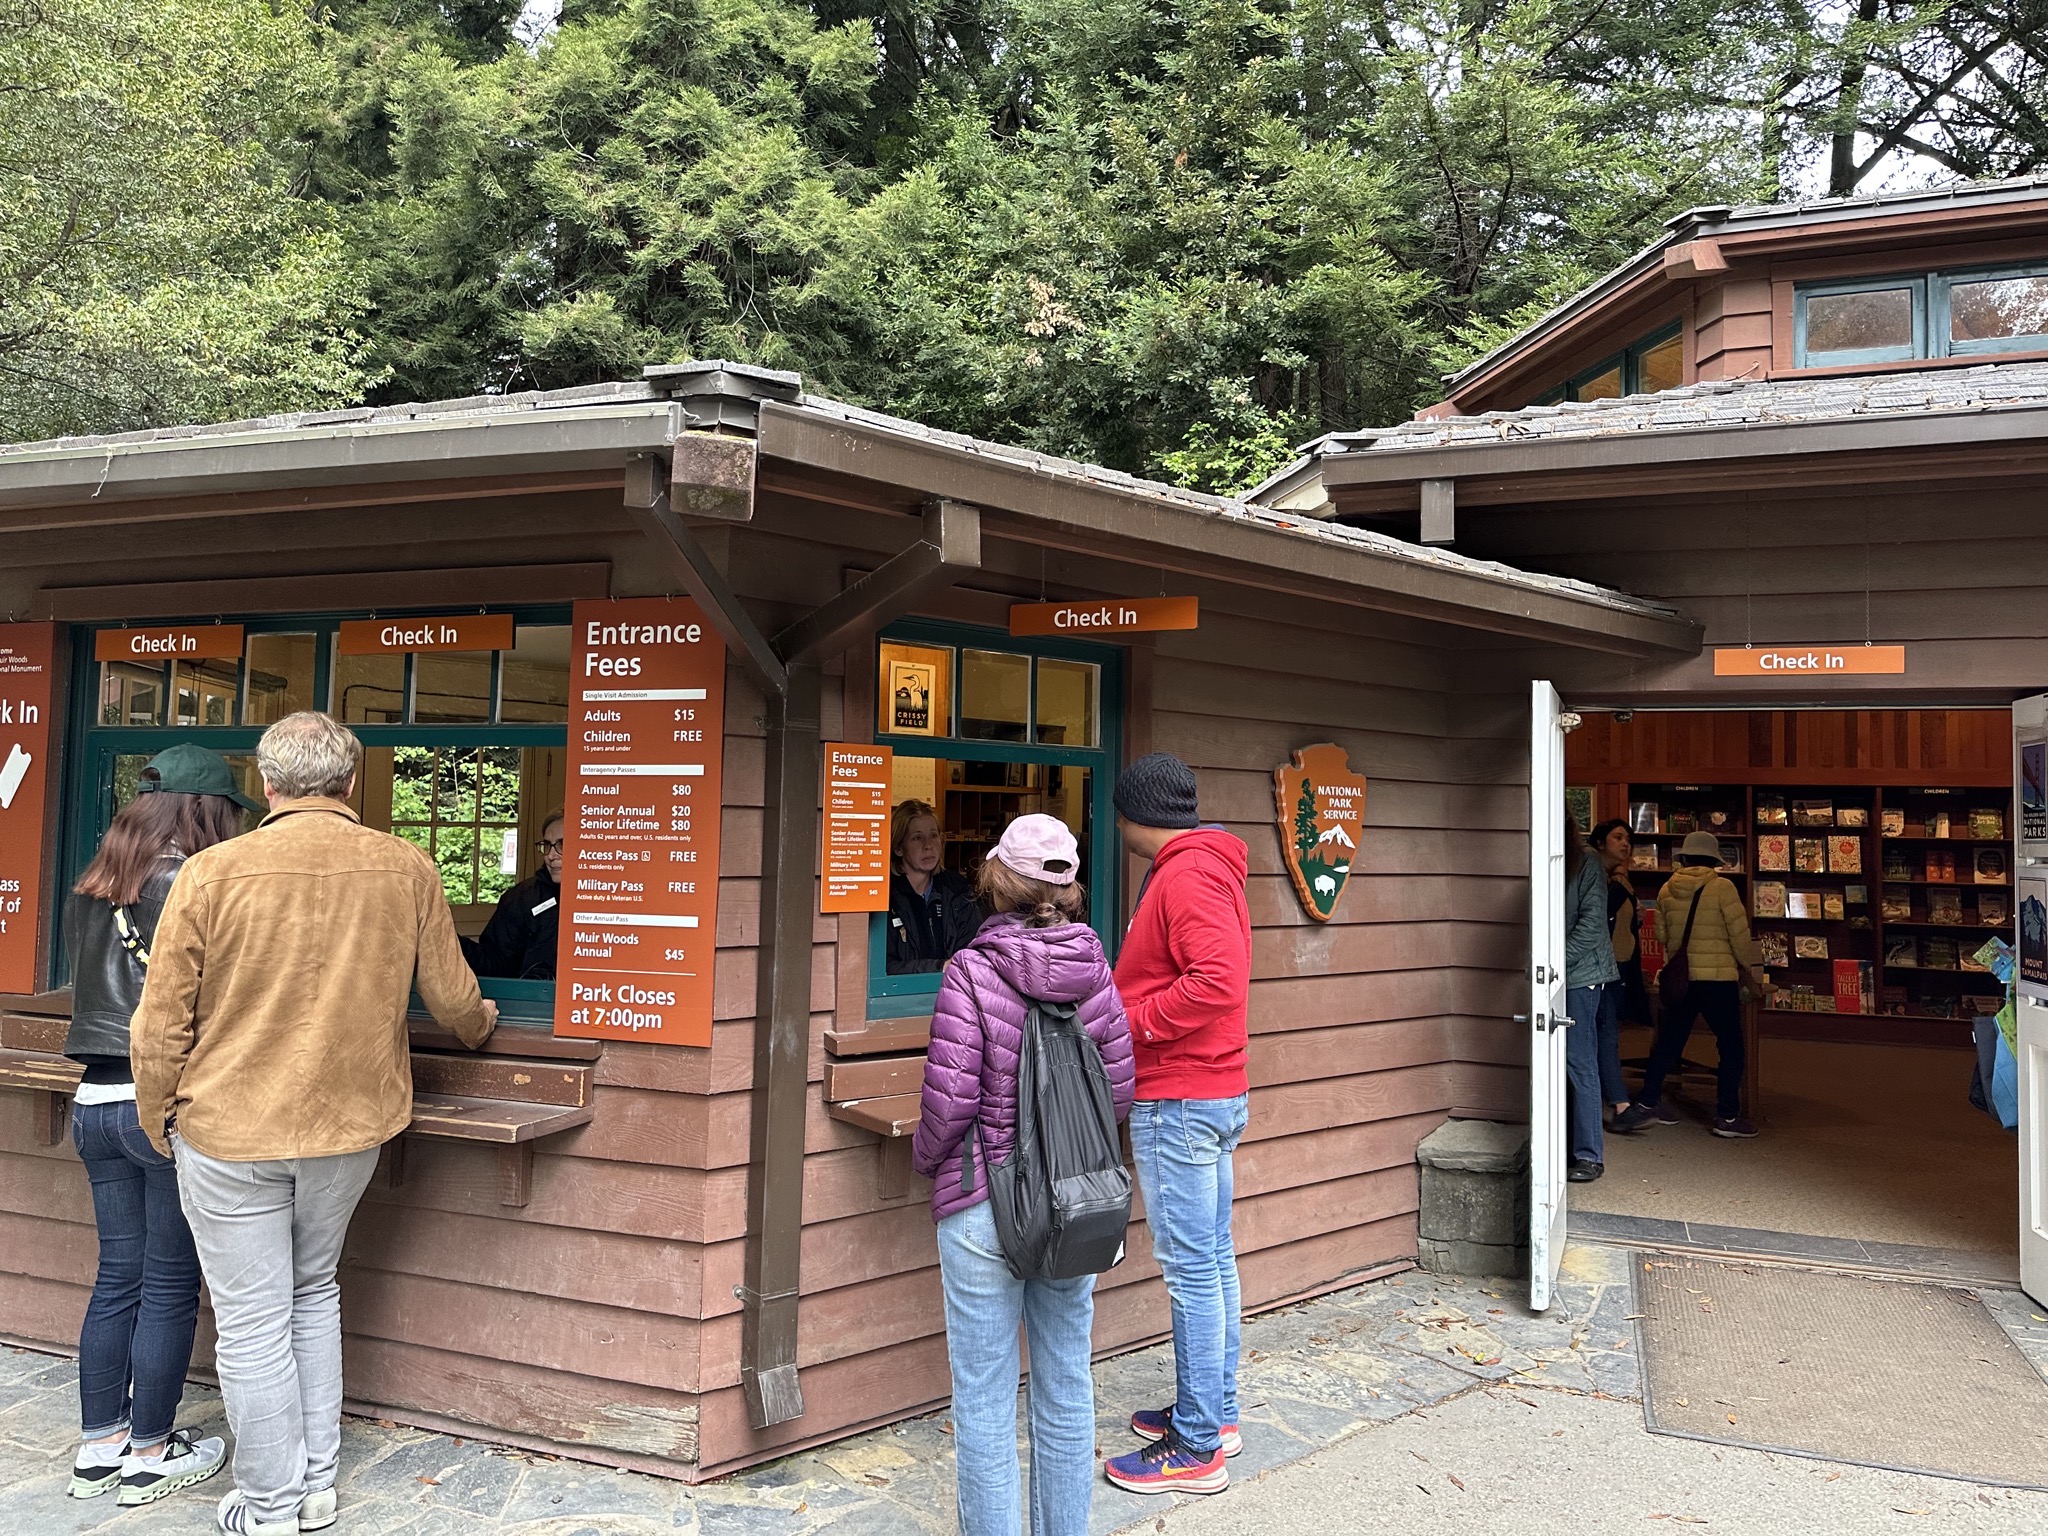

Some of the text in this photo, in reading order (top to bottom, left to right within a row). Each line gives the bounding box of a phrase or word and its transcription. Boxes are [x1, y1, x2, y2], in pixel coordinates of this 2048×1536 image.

[1054, 606, 1137, 628] Check In
[380, 624, 457, 646] Check In
[586, 621, 701, 646] Entrance
[130, 633, 197, 653] Check In
[0, 655, 28, 664] uir Woods
[585, 652, 642, 677] Fees
[1759, 652, 1844, 669] Check In
[10, 664, 42, 673] Monument
[585, 691, 648, 701] Single Visit Admission
[19, 700, 38, 724] In
[583, 708, 695, 722] Adults $15
[897, 711, 927, 721] CRISSY
[899, 719, 924, 727] FIELD
[583, 729, 703, 743] Children FREE
[590, 746, 604, 754] years
[832, 751, 884, 766] Entrance
[582, 766, 616, 774] Interagency
[832, 764, 858, 777] Fees
[581, 783, 692, 797] Annual $80
[1317, 785, 1363, 797] NATIONAL
[831, 798, 854, 806] Children
[1328, 798, 1352, 808] PARK
[580, 804, 691, 818] Senior Annual $20
[1322, 810, 1358, 820] SERVICE
[580, 818, 691, 832] Senior Lifetime $80
[2024, 826, 2046, 837] PARKS
[604, 833, 617, 842] years
[679, 835, 692, 844] only
[578, 849, 697, 863] Access Pass FREE
[588, 863, 613, 871] residents
[612, 863, 625, 872] only
[0, 879, 20, 893] ass
[577, 879, 696, 894] Military Pass FREE
[6, 896, 22, 914] of
[576, 893, 593, 901] Active
[592, 894, 606, 903] duty
[611, 894, 634, 902] Veteran
[575, 914, 593, 922] Other
[593, 914, 615, 922] Annual
[574, 931, 640, 945] Muir Woods
[573, 945, 685, 961] Annual $45
[2025, 957, 2043, 969] MOUNT
[2021, 967, 2047, 980] TAMALPAIS
[572, 982, 676, 1006] Park Closes
[1837, 982, 1858, 996] TREE
[570, 1007, 662, 1032] at 7:00pm
